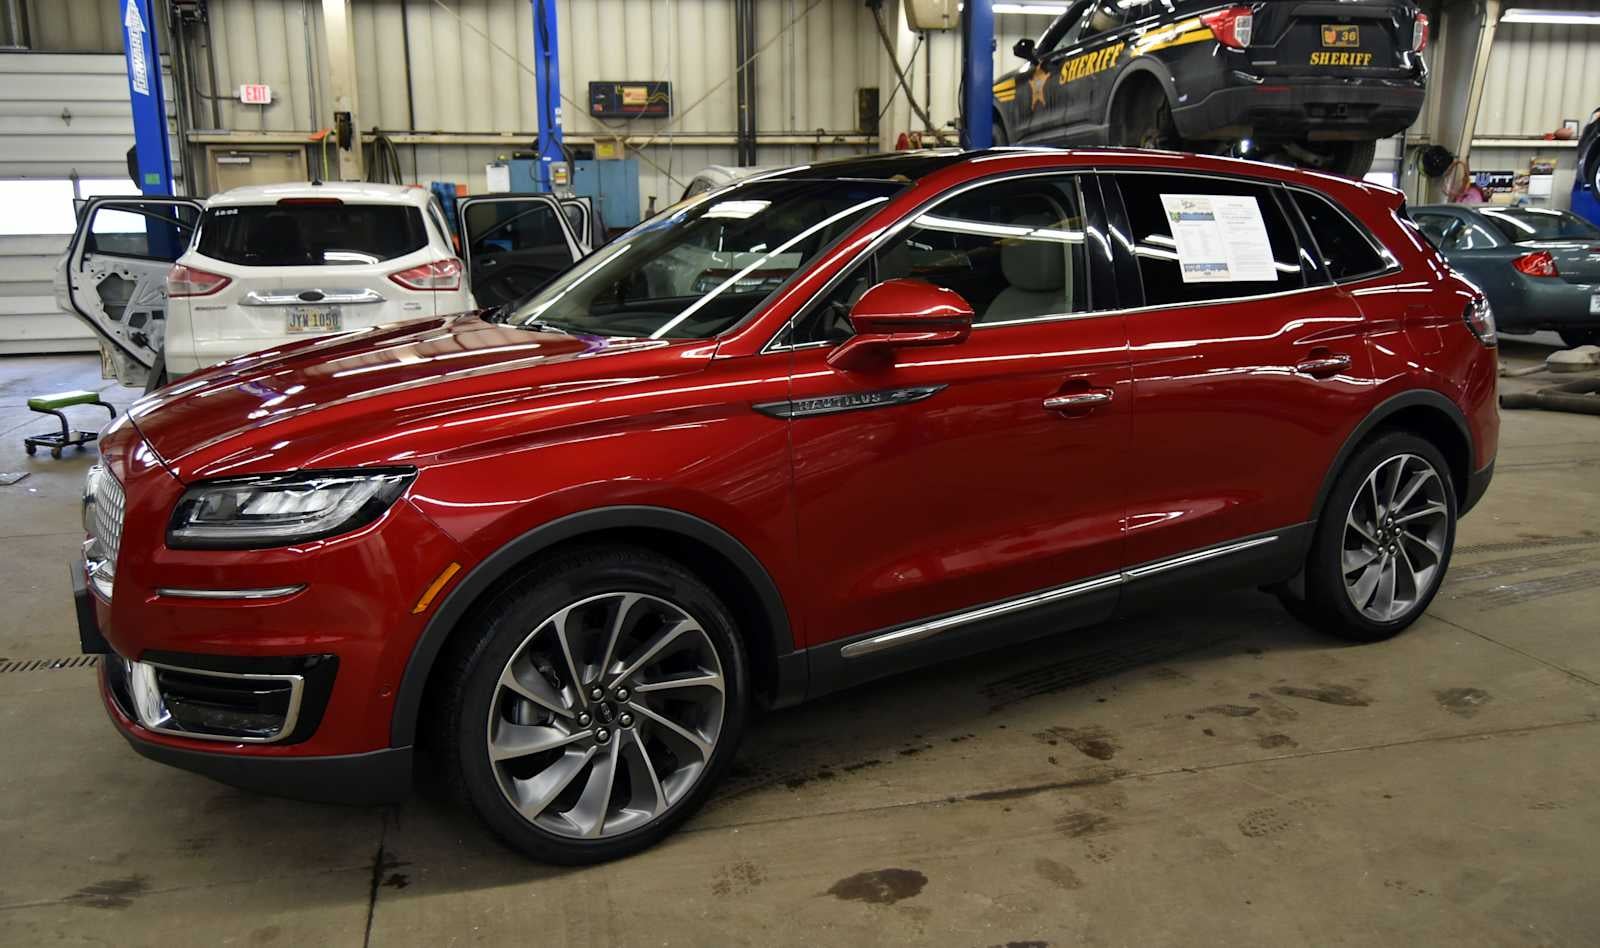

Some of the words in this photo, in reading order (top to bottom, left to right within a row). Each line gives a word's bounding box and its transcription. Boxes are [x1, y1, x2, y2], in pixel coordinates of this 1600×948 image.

[1341, 31, 1358, 41] 36
[1059, 40, 1125, 85] SHERIFF
[1309, 51, 1373, 66] SHERIFF
[244, 86, 267, 102] EXIT
[797, 393, 881, 411] NAUTILUS
